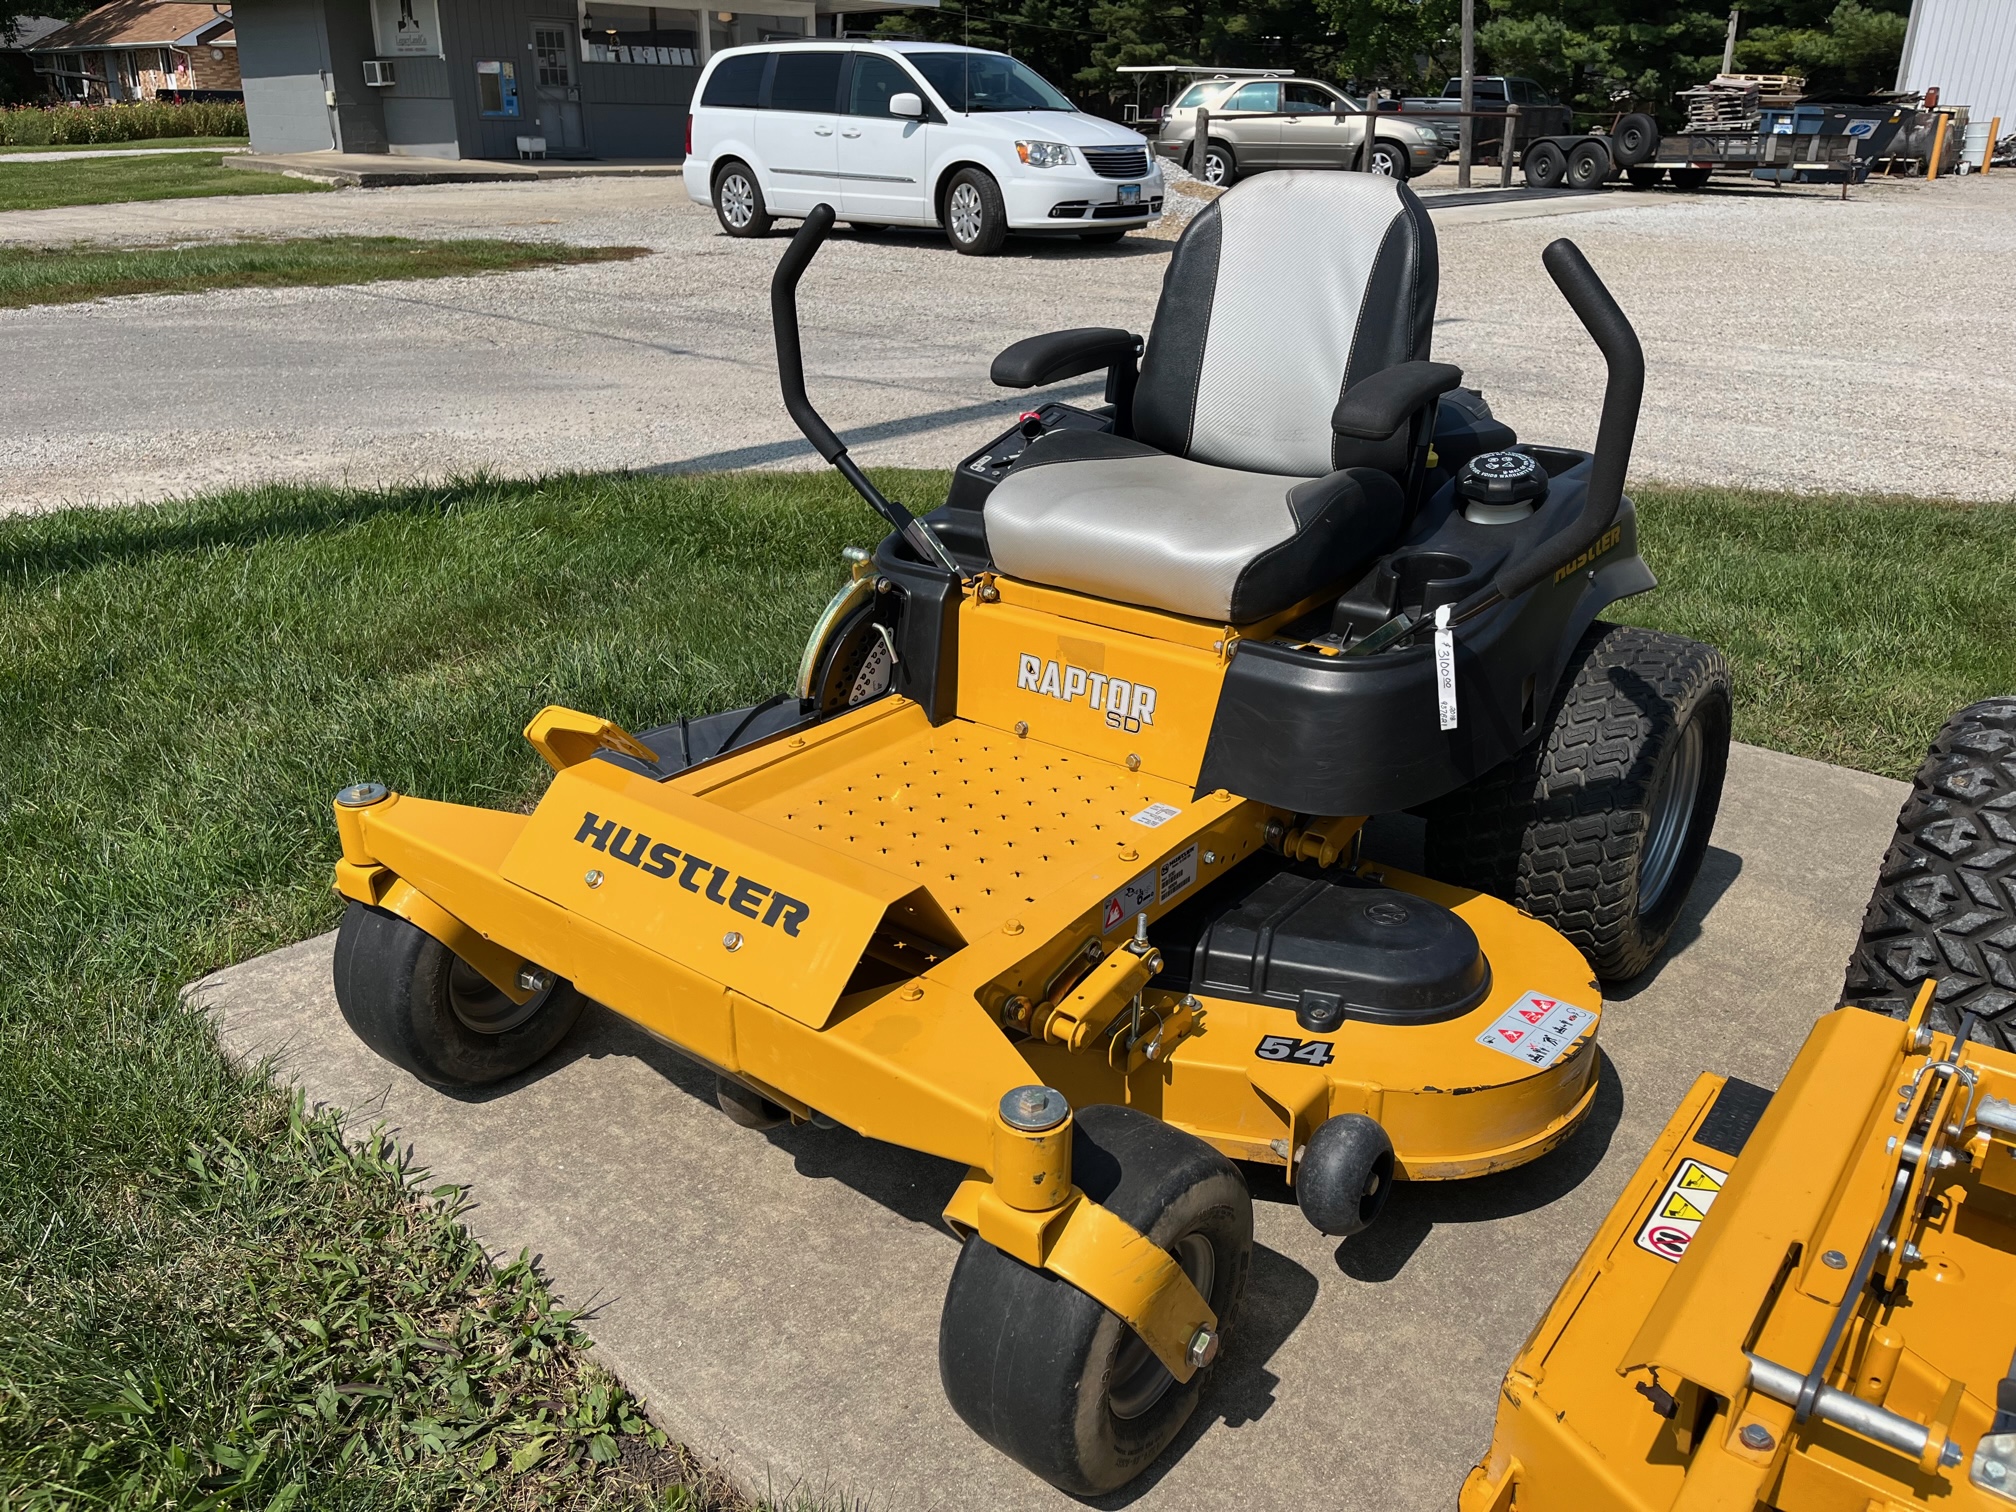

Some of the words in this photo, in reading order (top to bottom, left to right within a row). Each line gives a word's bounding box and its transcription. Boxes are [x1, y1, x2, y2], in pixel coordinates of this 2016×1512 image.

[1017, 653, 1157, 726] RAPTOR
[1105, 711, 1141, 734] SD
[573, 811, 810, 938] HUSTLER
[1257, 1036, 1329, 1065] 54
